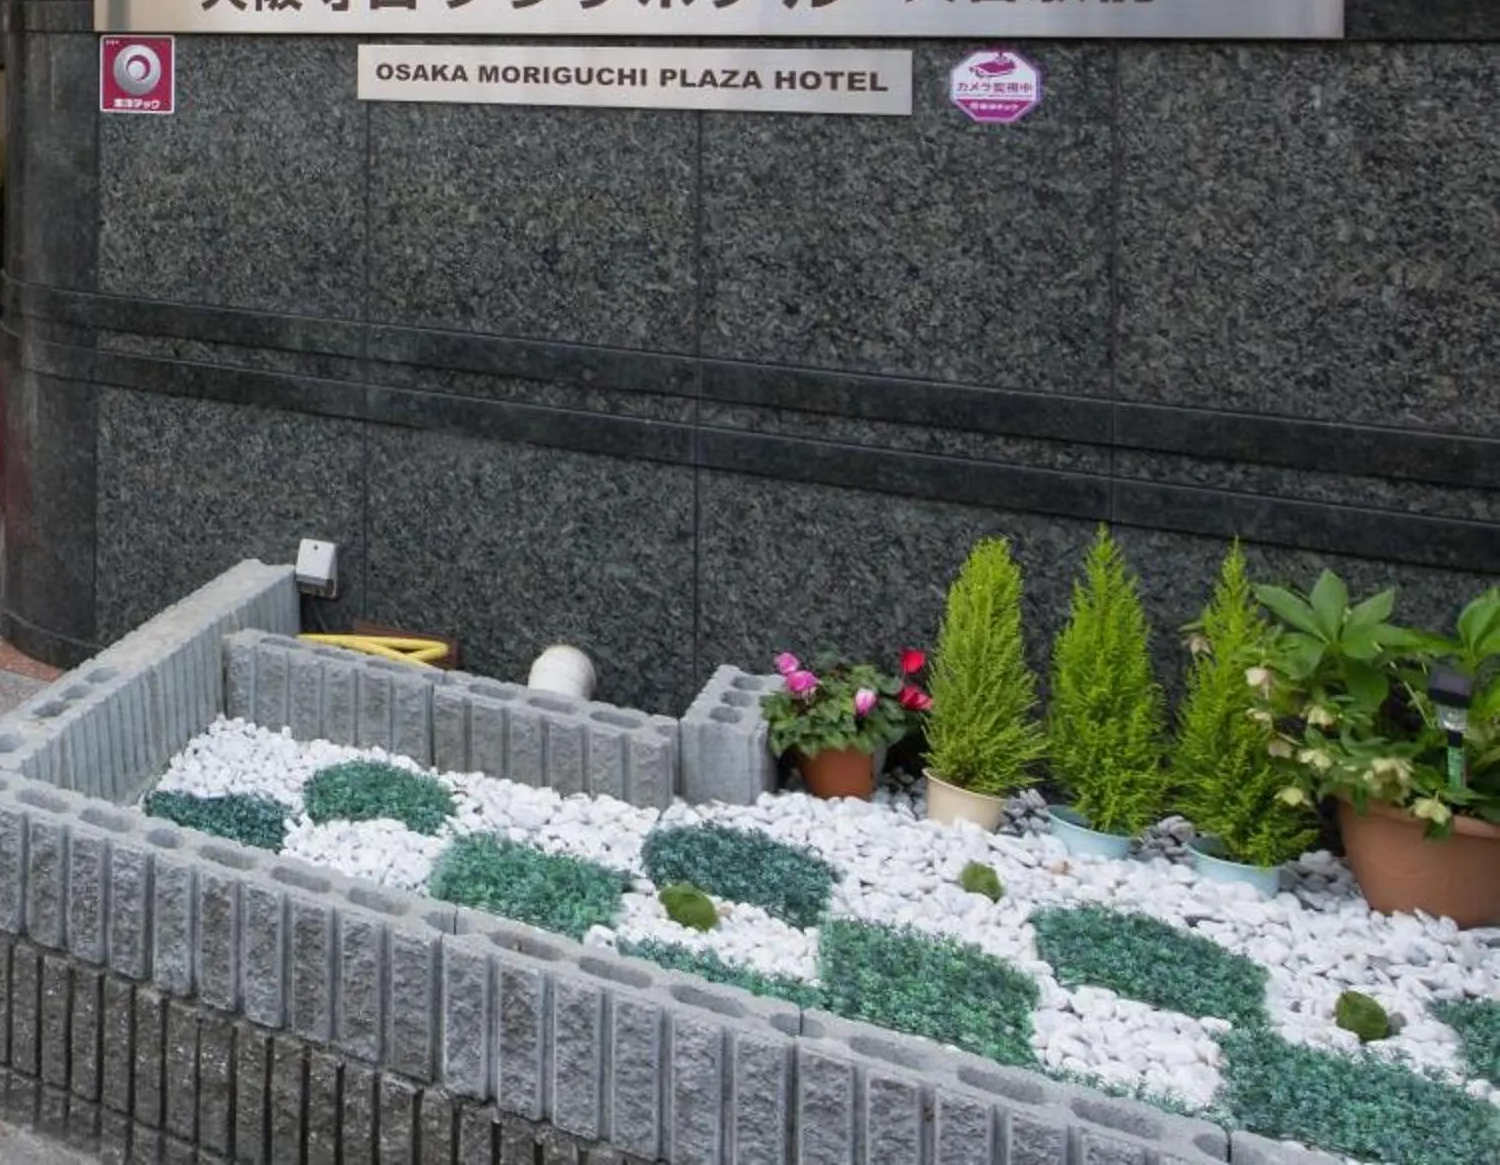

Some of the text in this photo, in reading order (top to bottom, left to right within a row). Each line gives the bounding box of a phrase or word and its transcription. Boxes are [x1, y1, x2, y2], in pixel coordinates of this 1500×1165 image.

[375, 62, 889, 92] OSAKA MORIGUCHI PLAZA HOTEL
